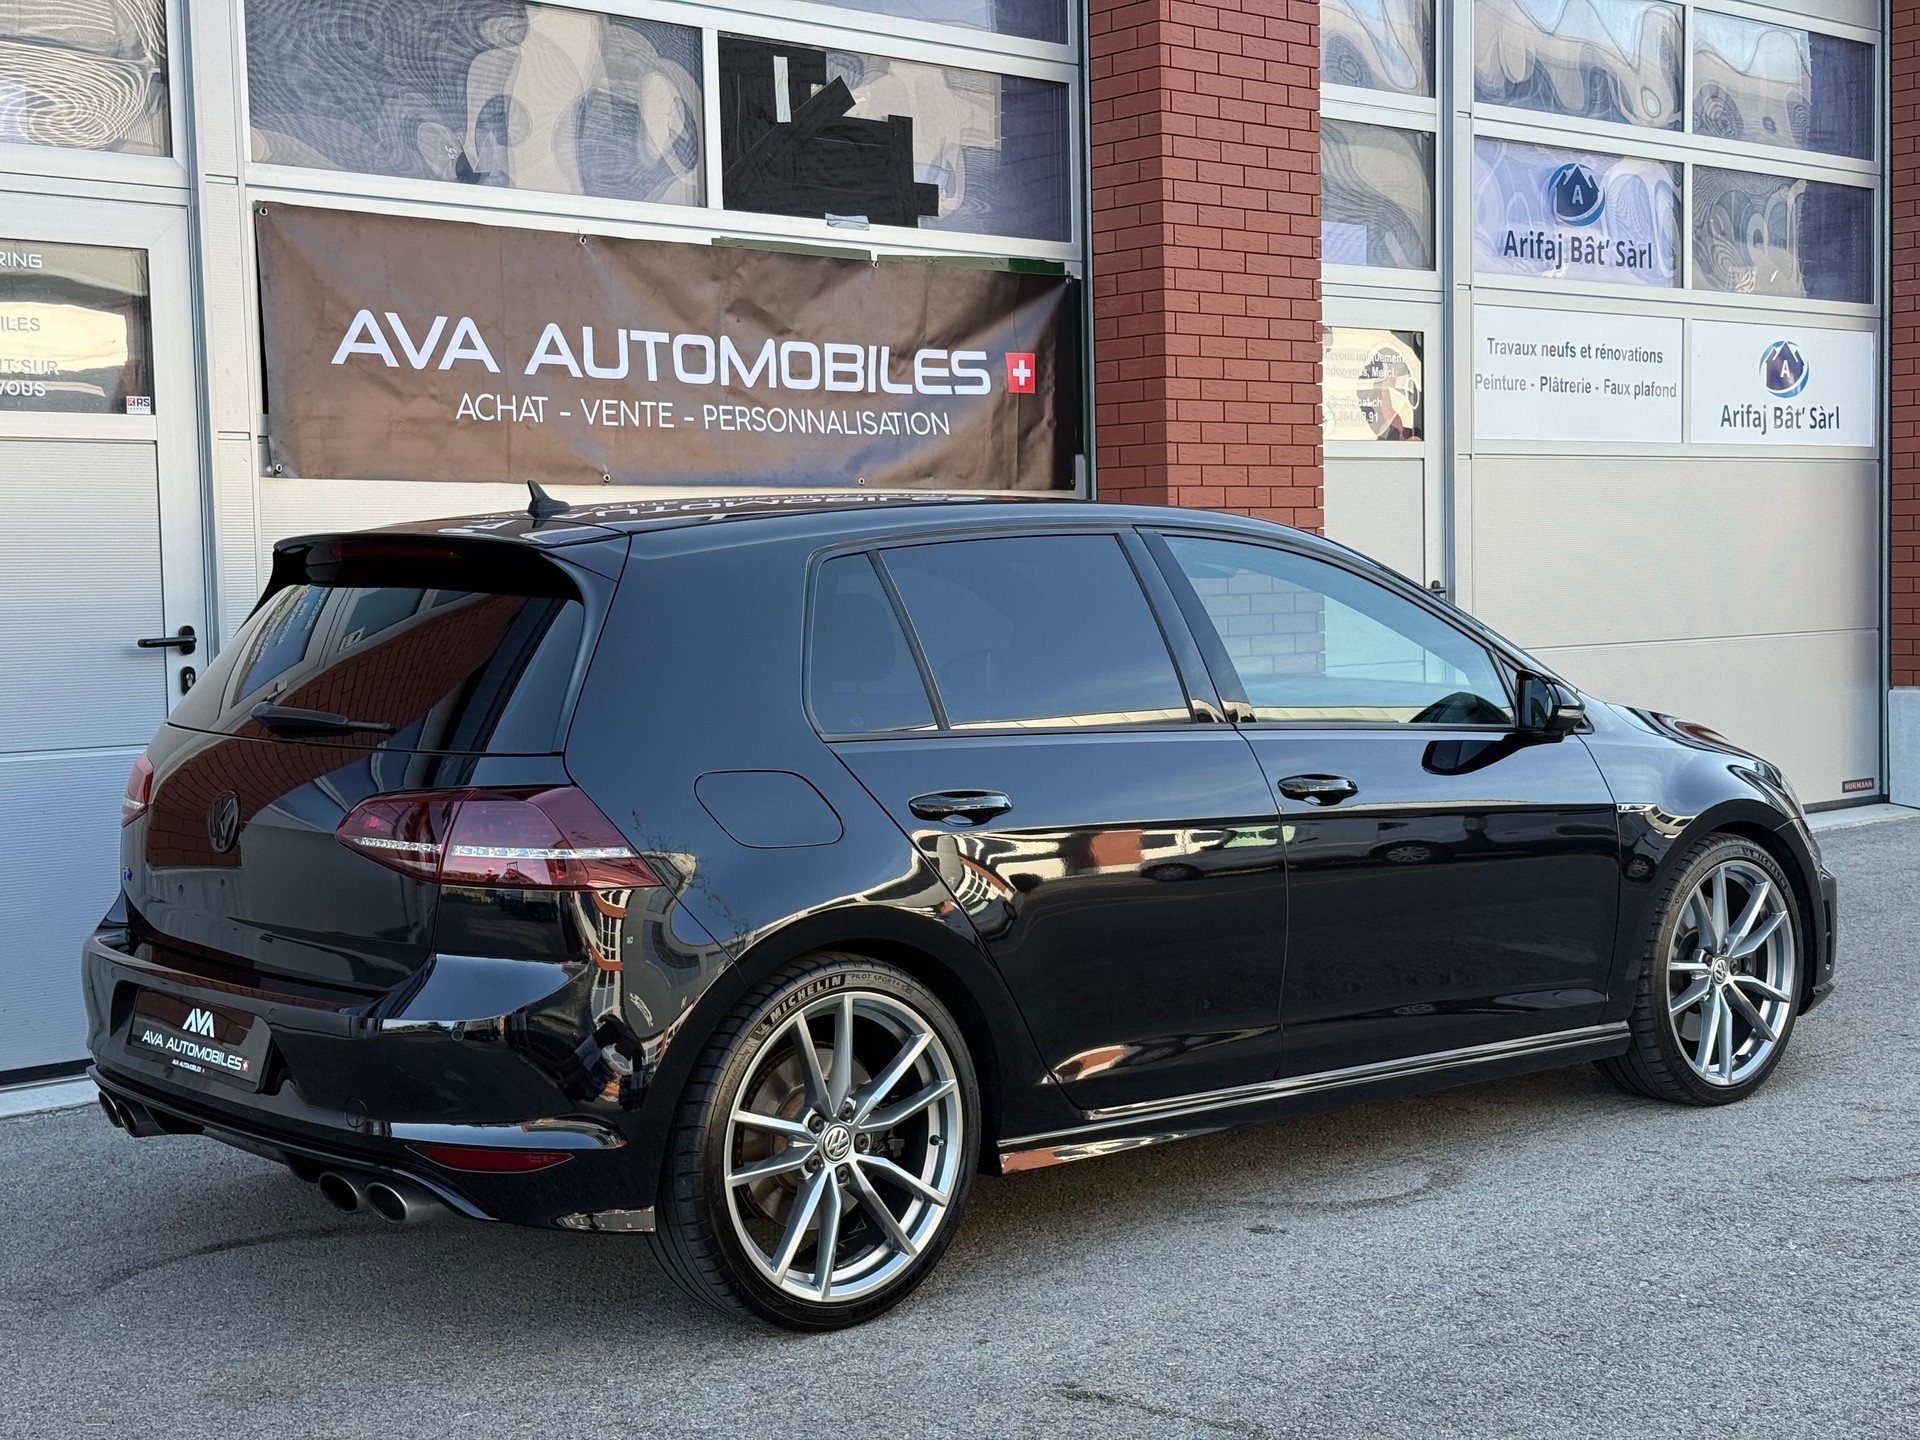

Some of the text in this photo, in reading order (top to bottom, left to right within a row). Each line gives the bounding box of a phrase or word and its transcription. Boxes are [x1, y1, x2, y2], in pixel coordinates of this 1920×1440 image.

[1571, 184, 1584, 205] A
[1503, 230, 1562, 270] Arifaj
[1616, 241, 1653, 269] Sàrl
[330, 309, 992, 396] AVA AUTOMOBILES
[1486, 337, 1664, 364] Travaux neufs et rénovations
[1475, 373, 1528, 392] Peinture
[1540, 375, 1593, 395] Plâtrerie
[1604, 378, 1632, 397] Faux
[1633, 381, 1678, 400] plafond
[1780, 359, 1791, 379] A
[455, 392, 549, 423] ACHAT
[580, 398, 675, 429] VENTE
[702, 404, 952, 437] PERSONNALISATION
[1720, 404, 1767, 435] Arifaj
[1809, 405, 1841, 430] Sàrl
[769, 975, 842, 1023] MICHELIN
[141, 1029, 243, 1071] AVA AUTOMOBILES
